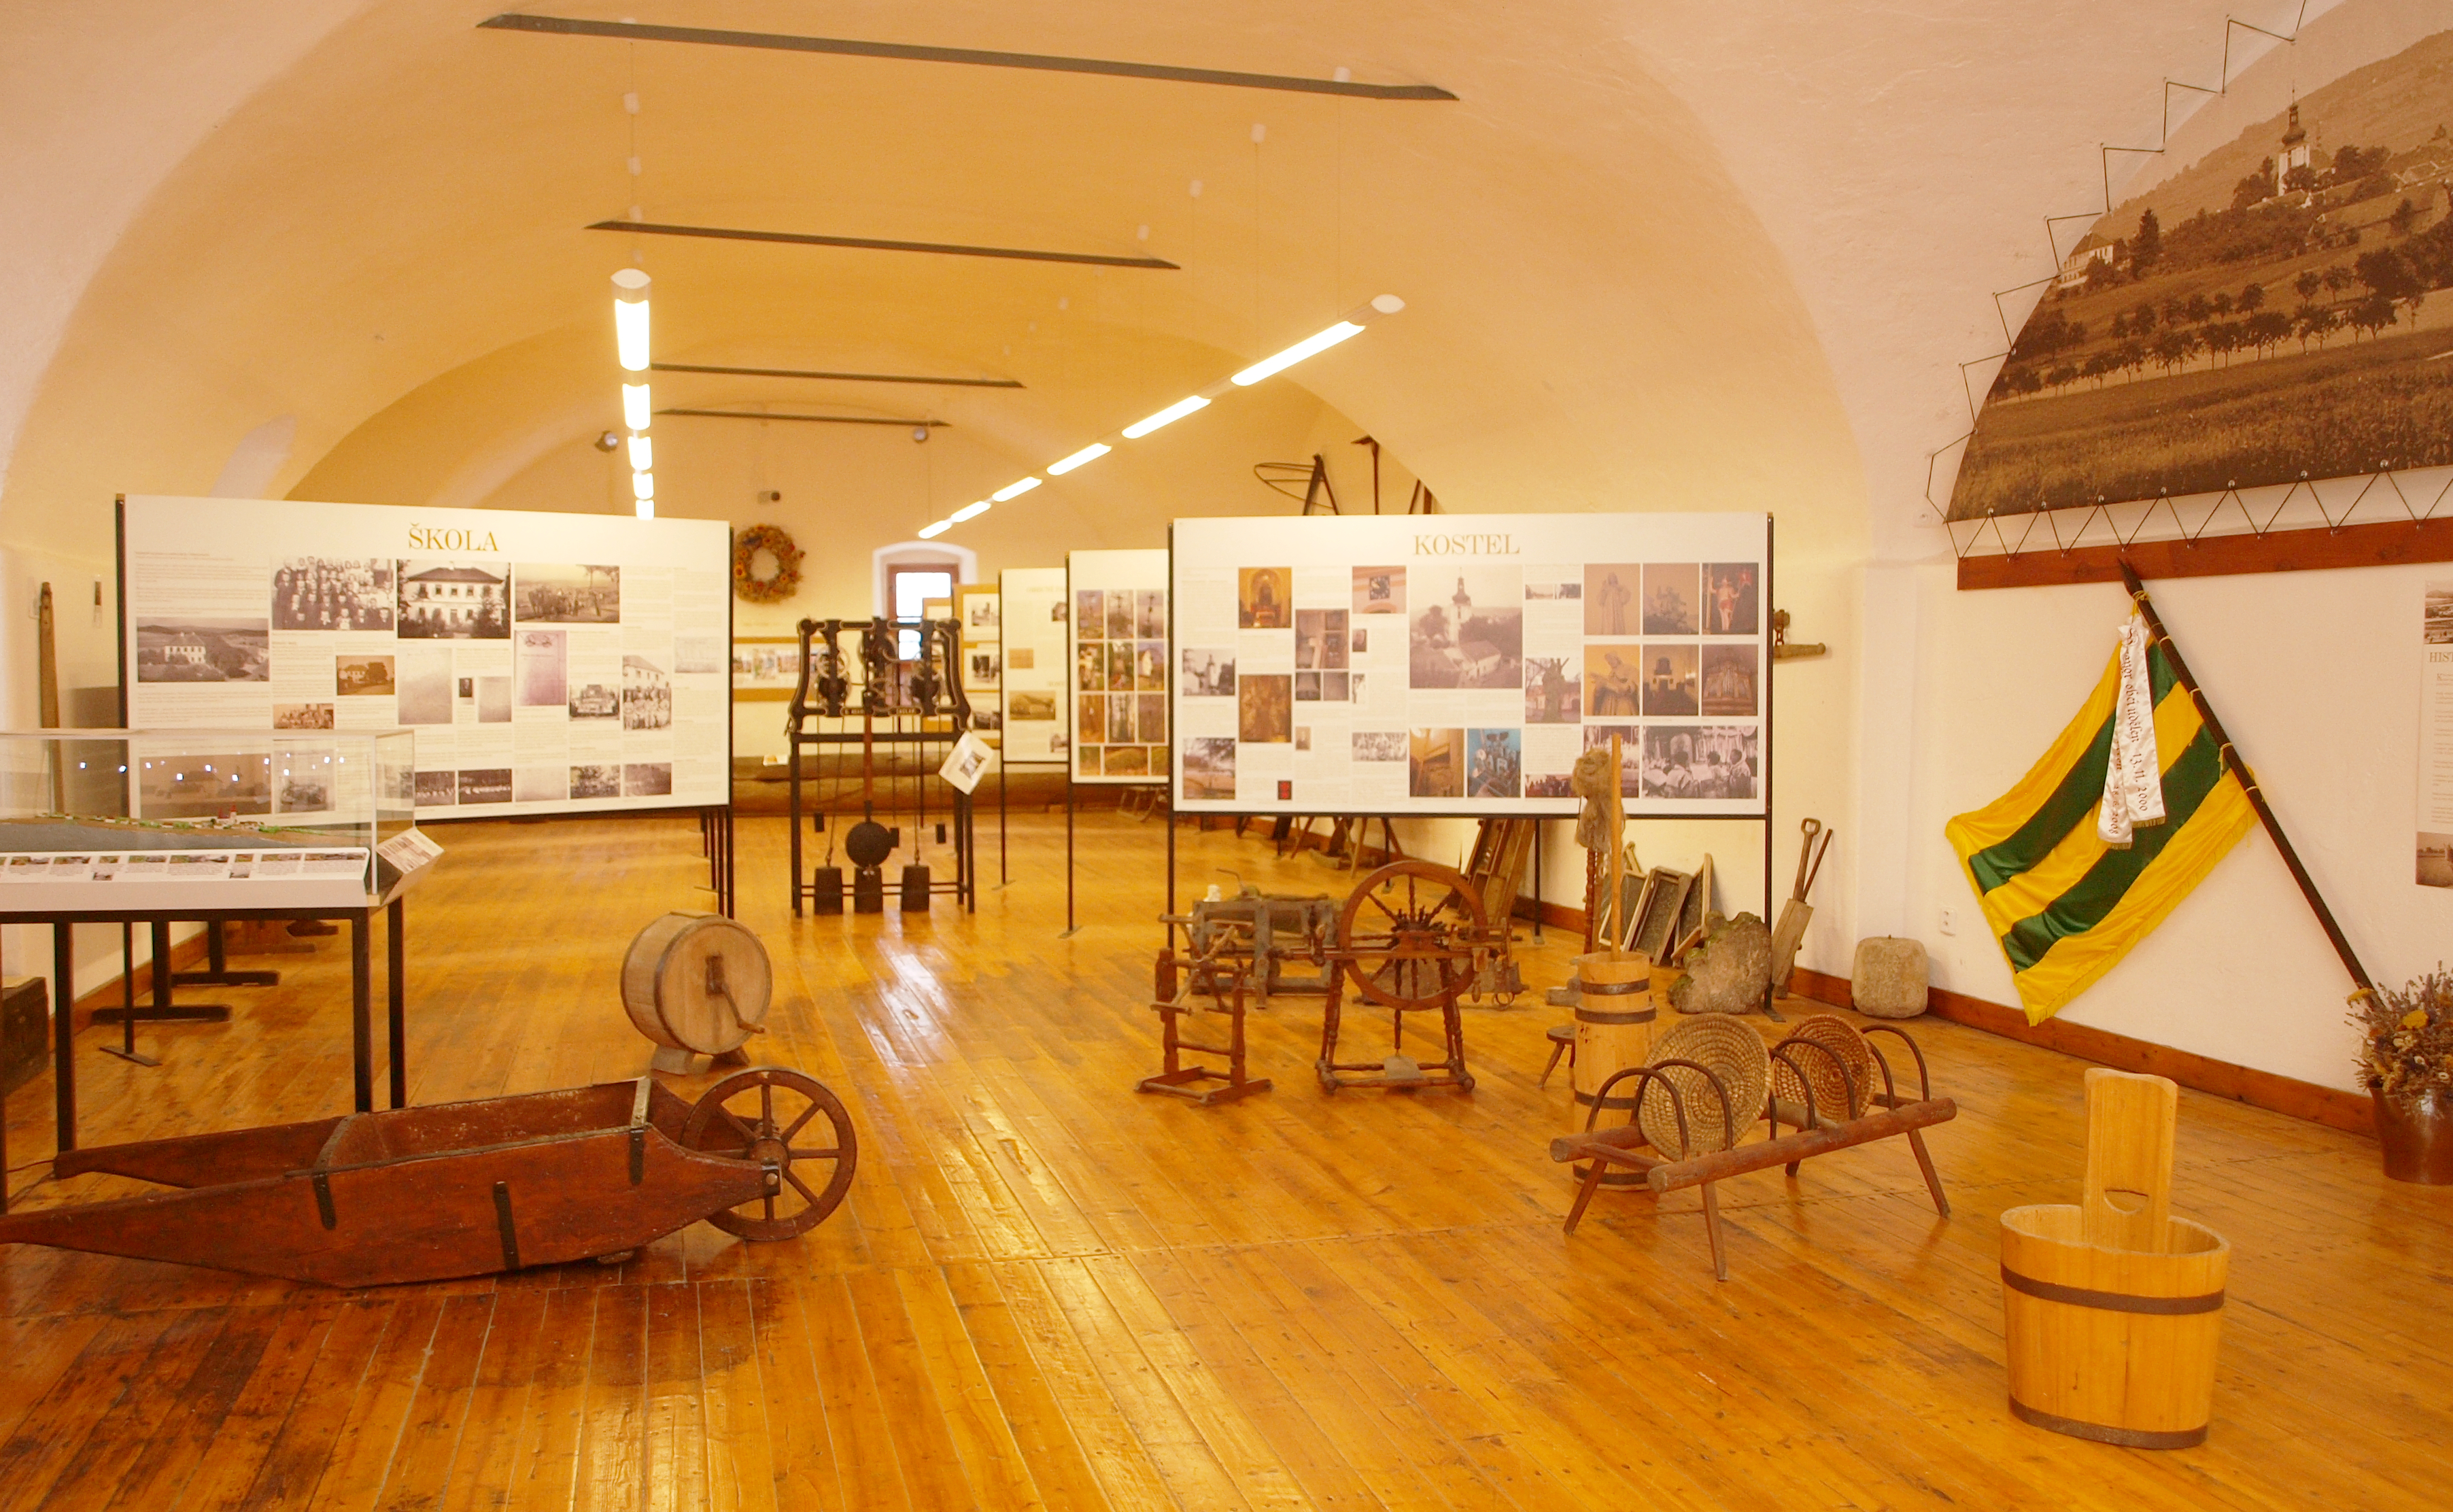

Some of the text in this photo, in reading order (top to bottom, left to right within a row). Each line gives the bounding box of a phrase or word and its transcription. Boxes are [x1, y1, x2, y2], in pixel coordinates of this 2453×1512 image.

[409, 522, 499, 551] ŠKOLA
[1413, 534, 1520, 555] KOSTEL
[2125, 684, 2139, 706] obci
[2130, 753, 2142, 768] 13.
[2135, 770, 2145, 783] 11.
[2137, 787, 2148, 811] 2000
[2108, 812, 2118, 834] 2008
